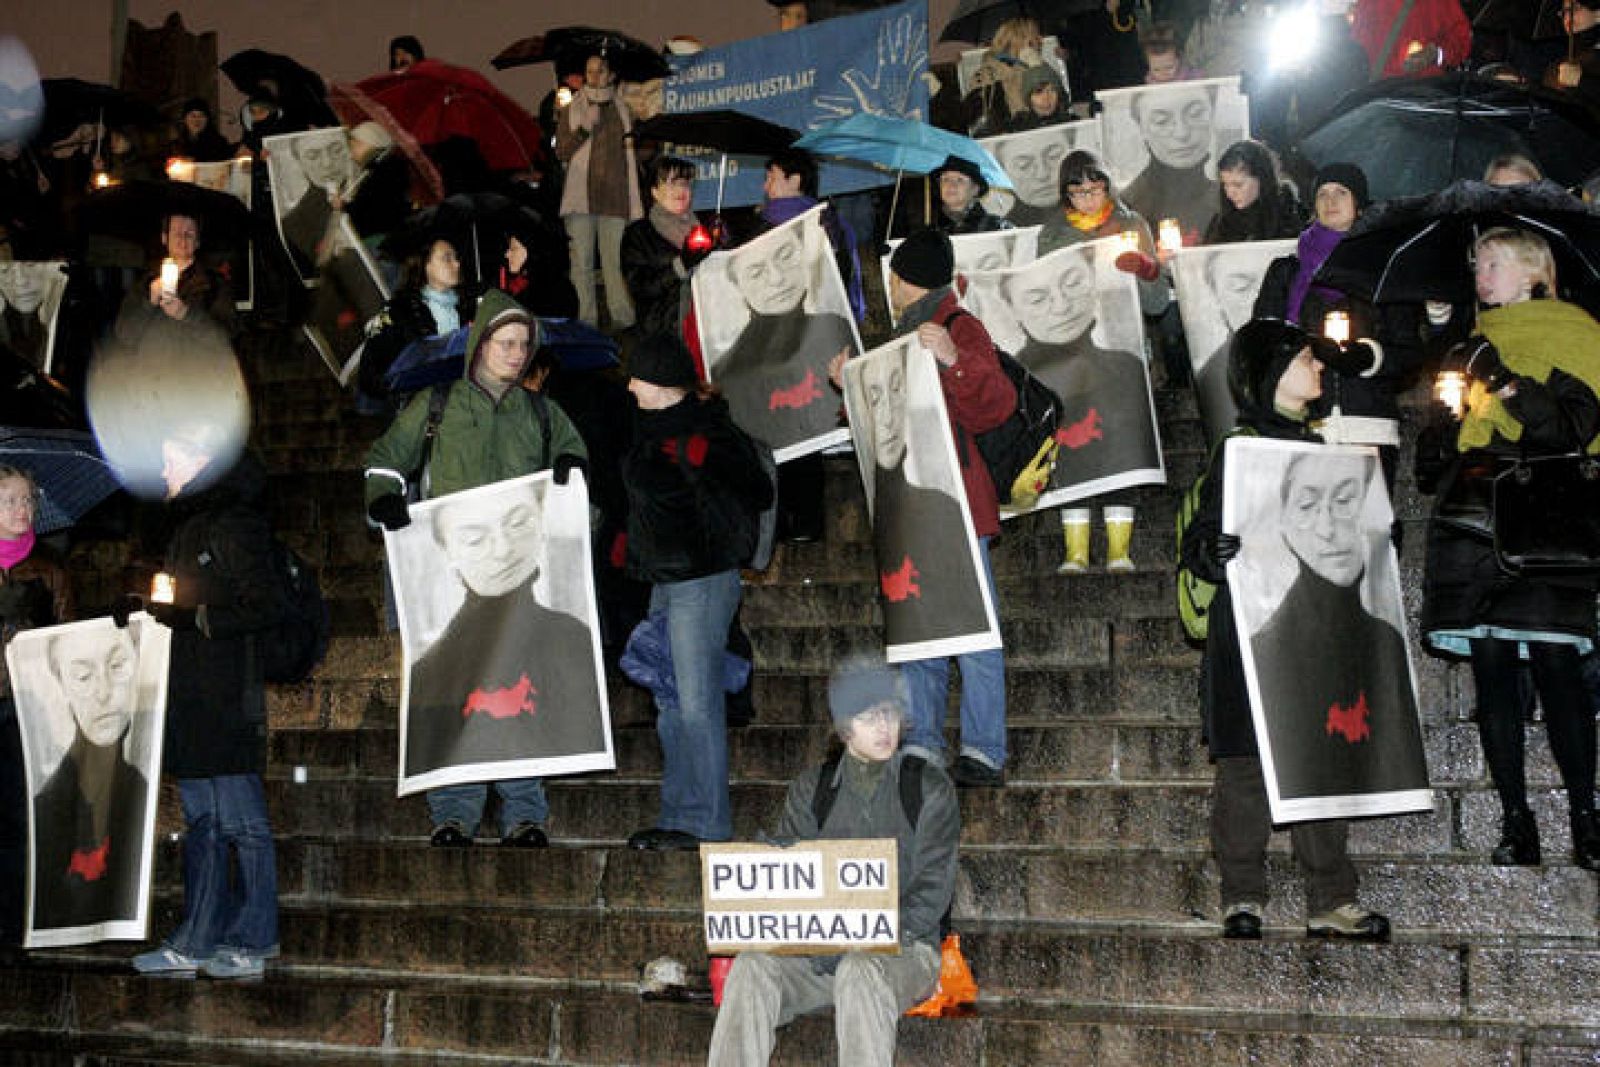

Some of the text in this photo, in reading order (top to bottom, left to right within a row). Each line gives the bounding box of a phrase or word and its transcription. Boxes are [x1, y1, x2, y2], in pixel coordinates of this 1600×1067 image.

[713, 861, 886, 891] PUTIN ON
[708, 913, 894, 940] MURHAAJA
